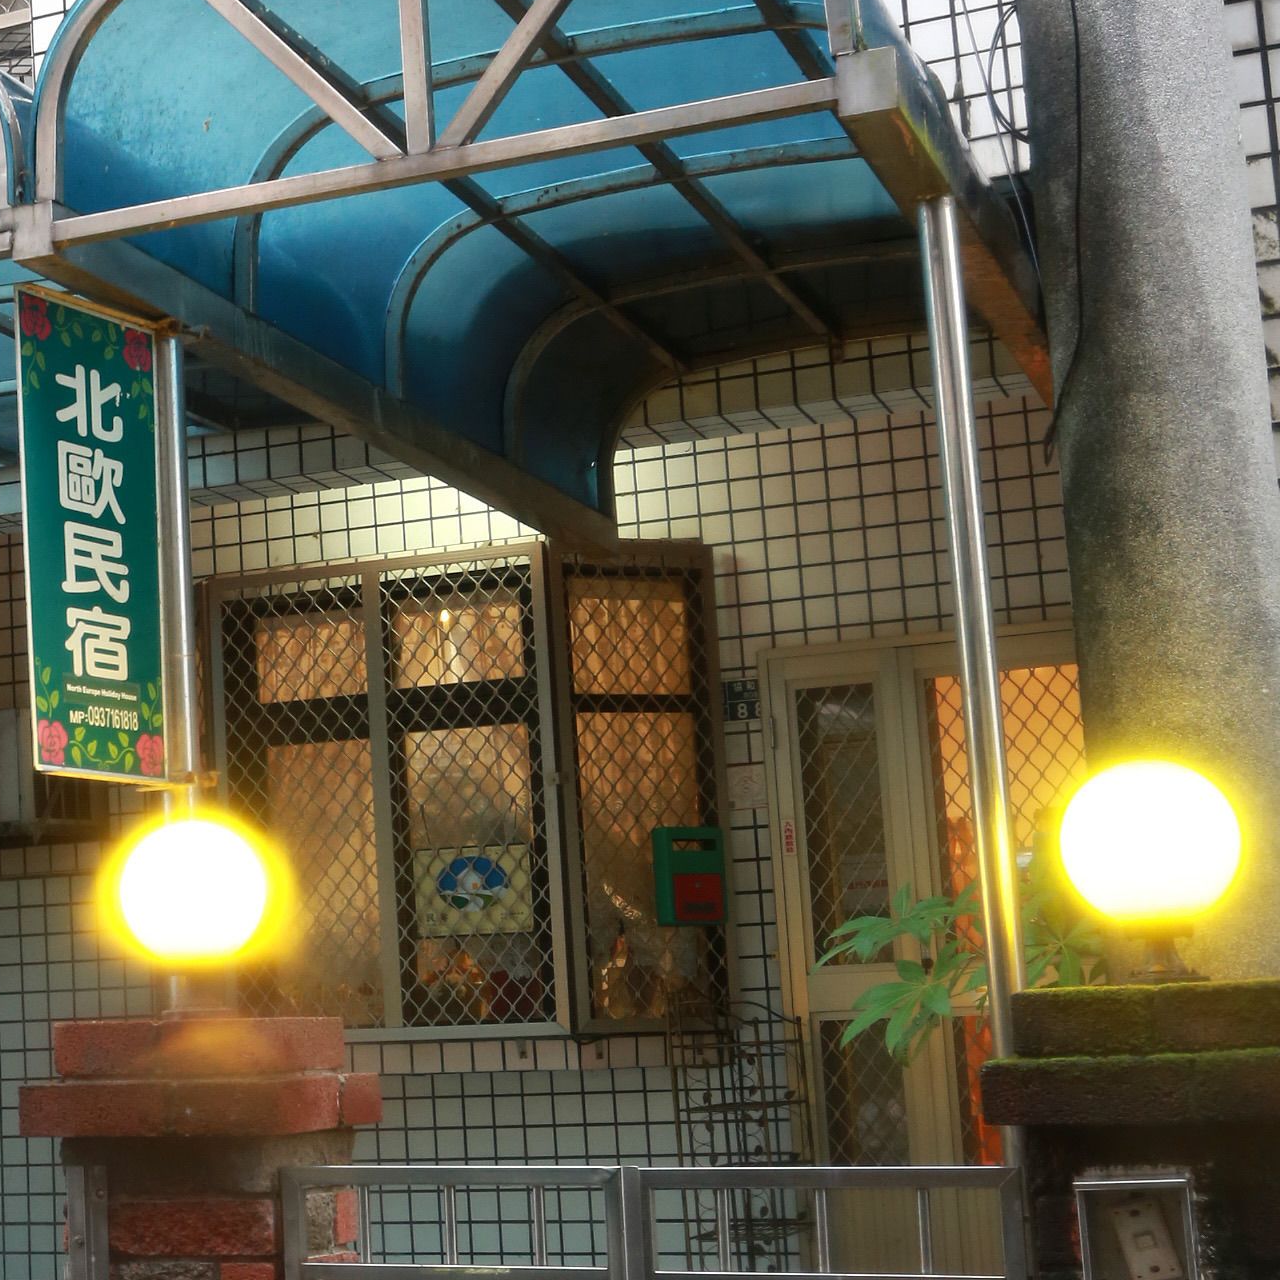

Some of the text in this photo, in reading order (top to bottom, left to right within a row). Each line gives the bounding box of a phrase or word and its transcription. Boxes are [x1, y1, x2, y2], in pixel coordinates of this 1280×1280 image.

[55, 364, 129, 682] 北歐民宿
[66, 683, 137, 701] North Europe Holiday House
